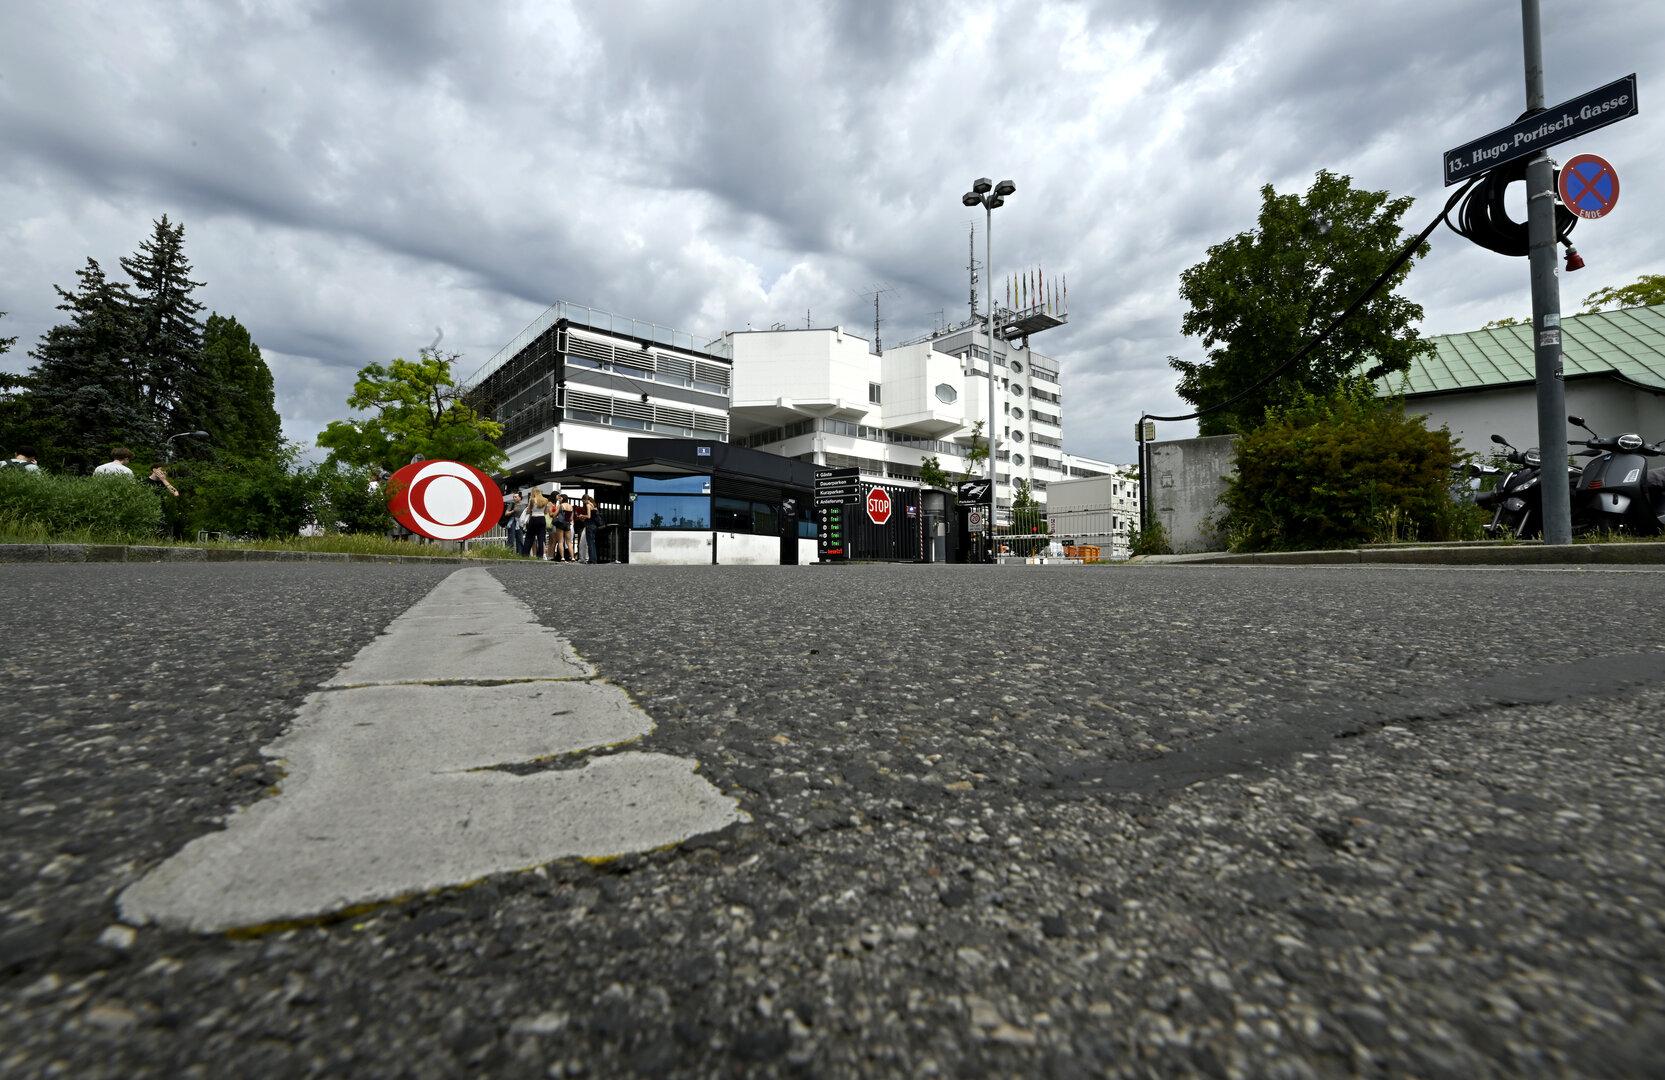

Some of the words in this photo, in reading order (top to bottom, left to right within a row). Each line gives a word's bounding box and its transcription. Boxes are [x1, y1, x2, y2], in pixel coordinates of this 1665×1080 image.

[1472, 93, 1629, 164] Hugo-Portisch-Gasse
[1579, 209, 1602, 219] ENDE
[868, 498, 889, 513] STOP
